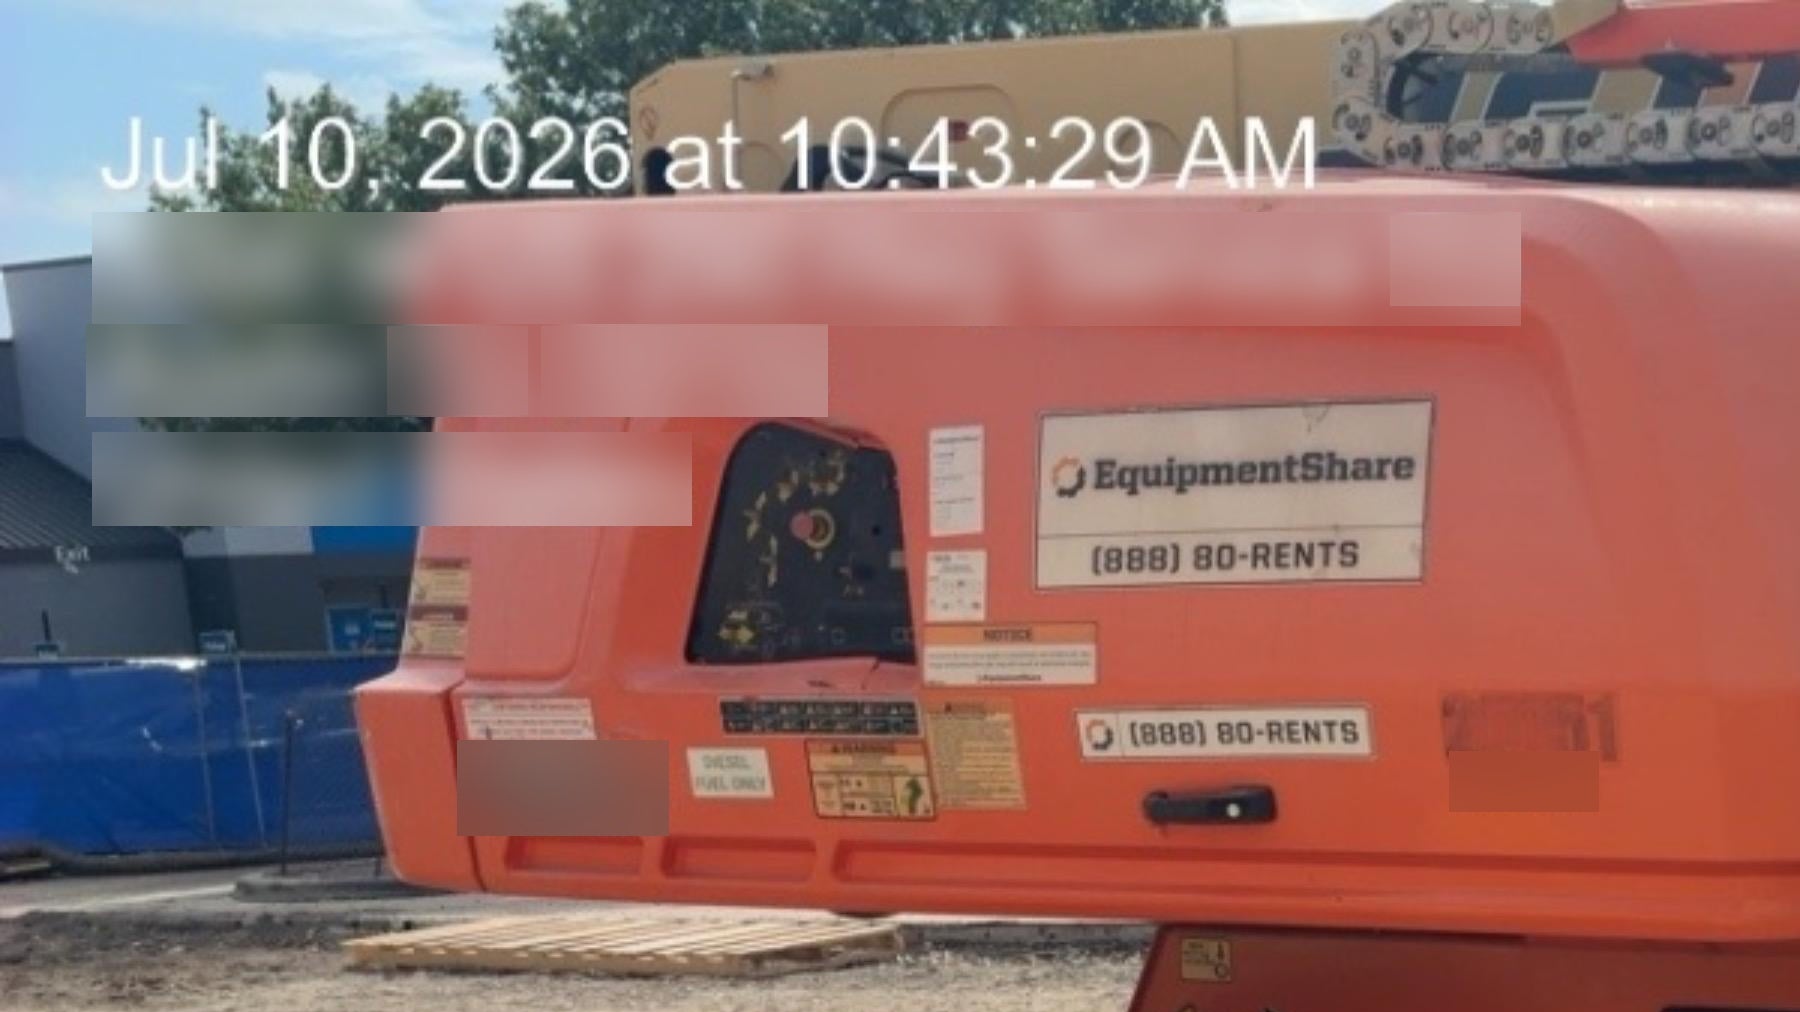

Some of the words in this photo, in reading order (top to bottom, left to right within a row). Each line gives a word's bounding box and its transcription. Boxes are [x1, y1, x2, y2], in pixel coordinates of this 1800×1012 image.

[1092, 451, 1417, 497] EquipmentShare
[1092, 543, 1181, 576] (888)
[1193, 540, 1360, 571] 80-RENTS
[1129, 720, 1207, 748] (888)
[1216, 719, 1360, 747] 80-RENTS
